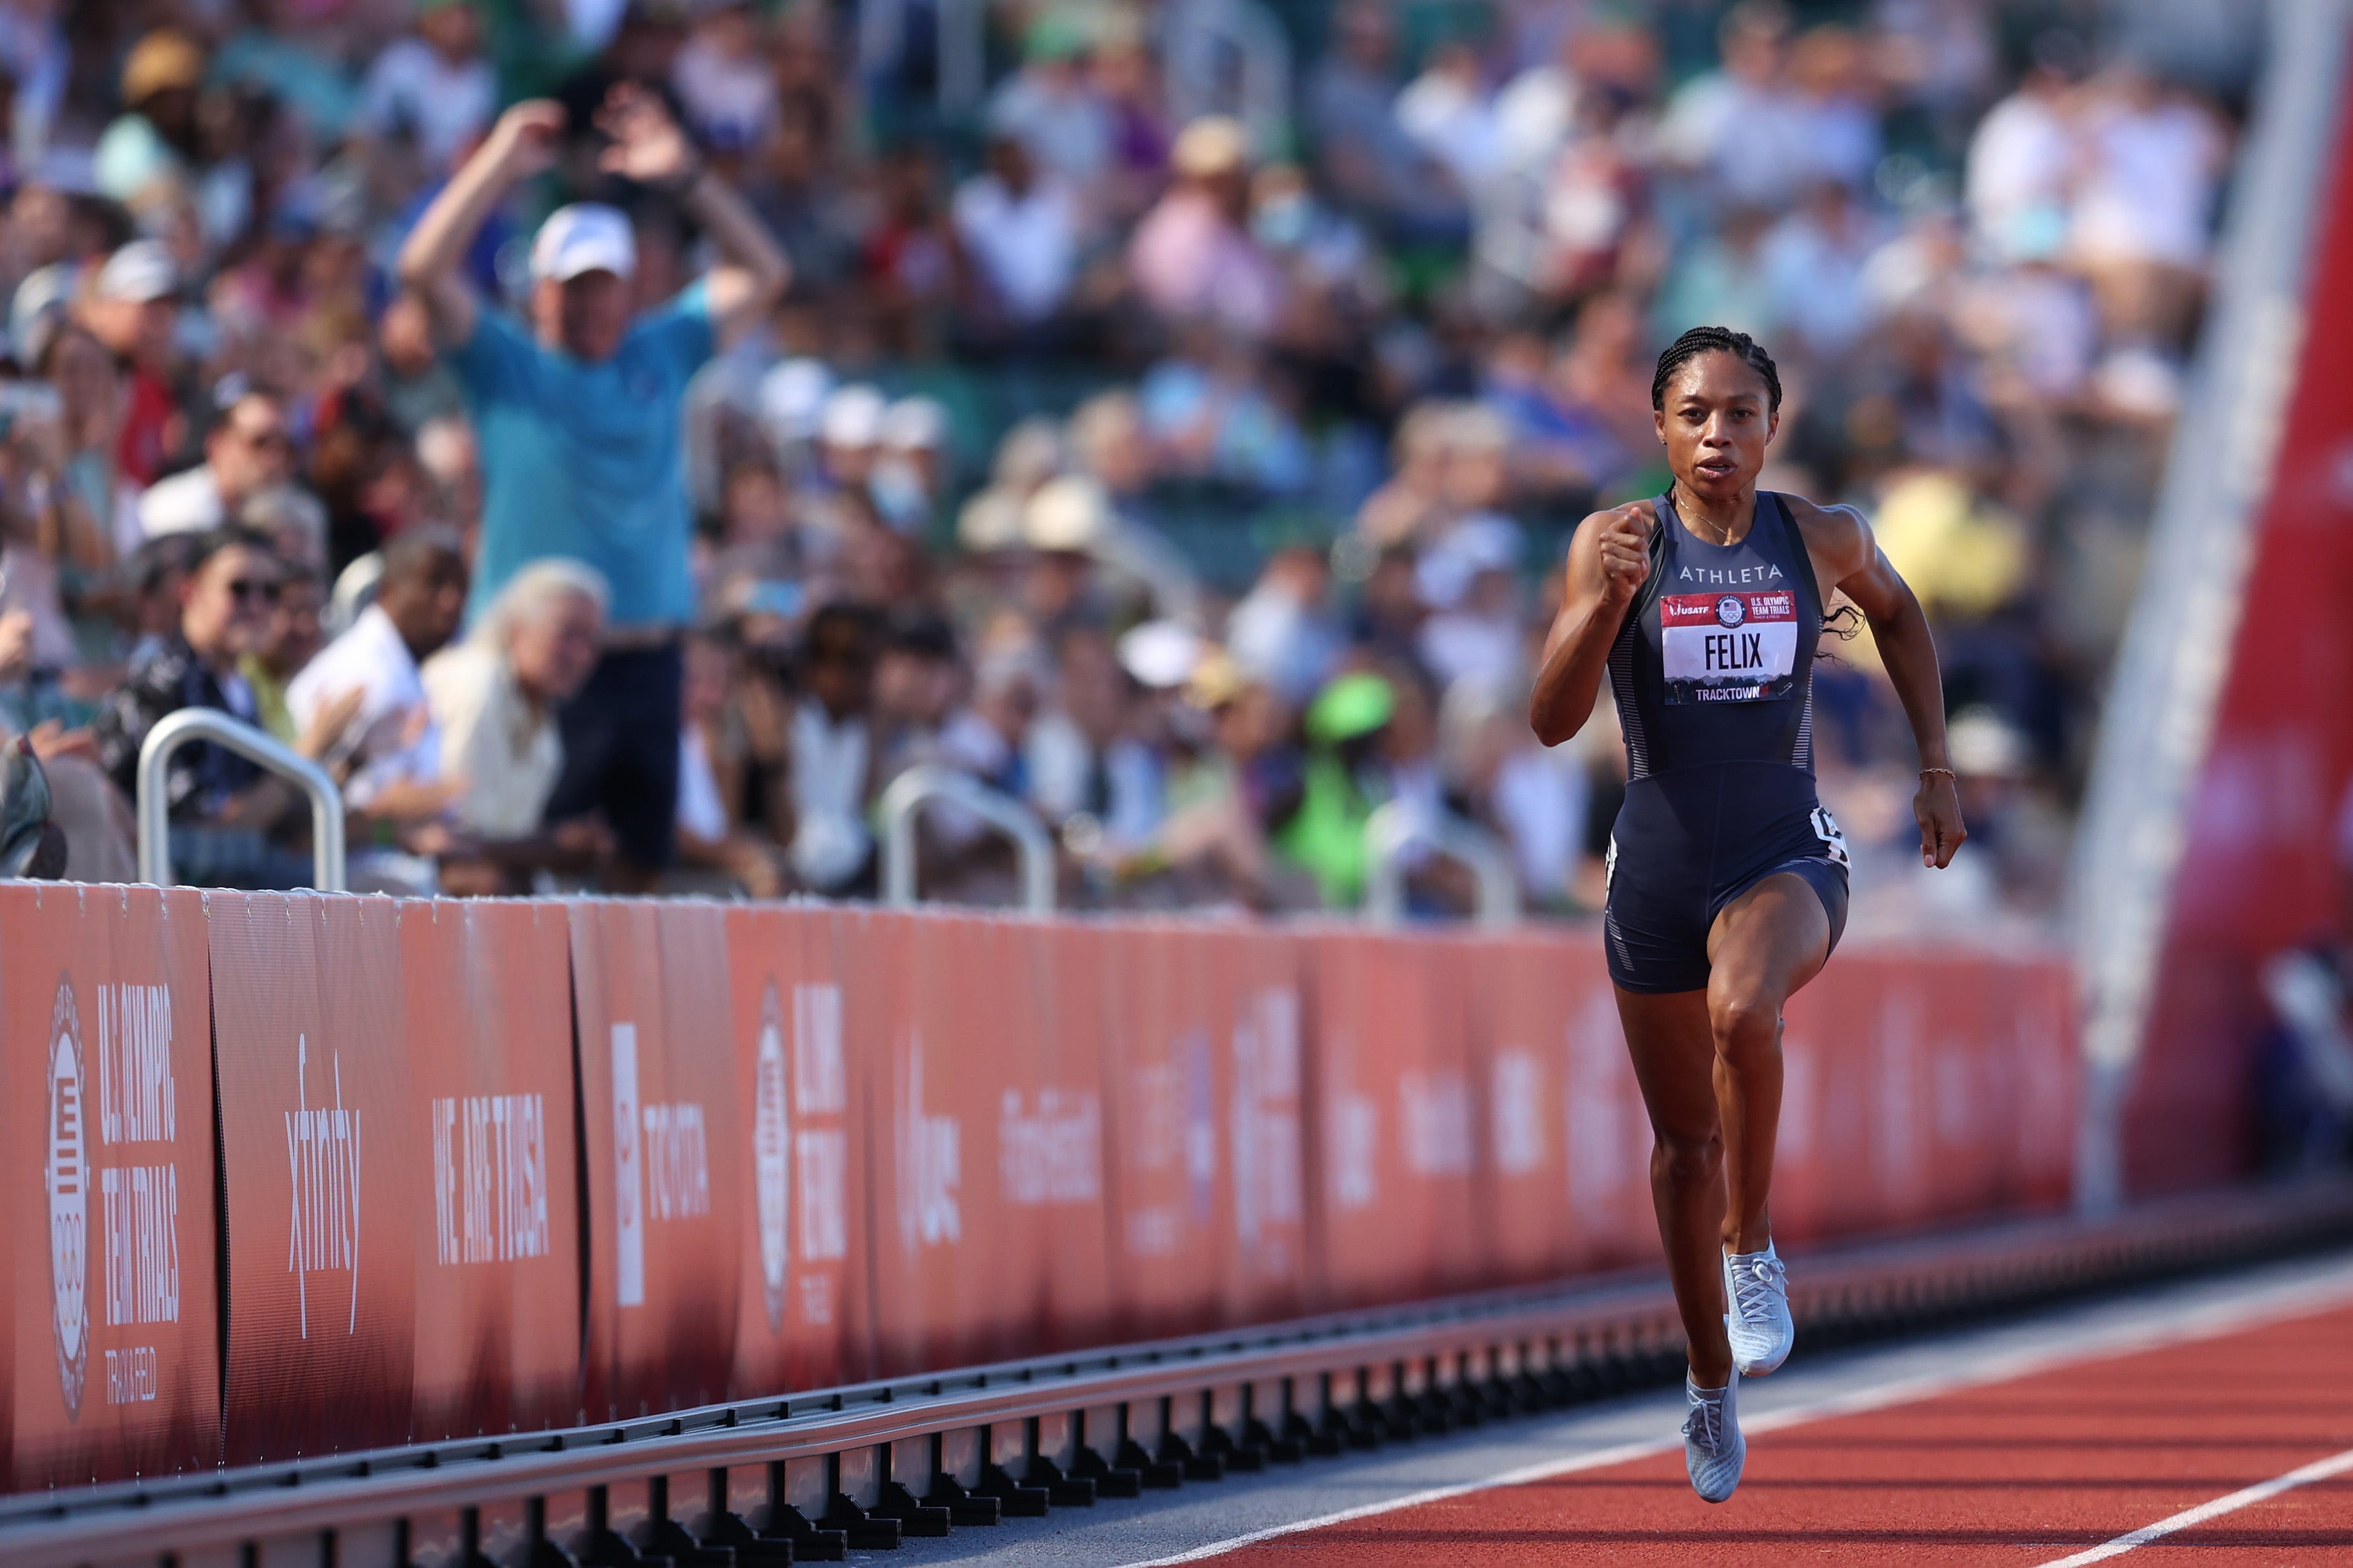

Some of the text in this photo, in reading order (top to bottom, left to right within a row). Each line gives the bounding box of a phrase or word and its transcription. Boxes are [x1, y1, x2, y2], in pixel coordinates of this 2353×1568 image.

[1679, 564, 1783, 584] ATHLETA
[1681, 606, 1709, 615] USATF
[1750, 596, 1789, 606] U.S. OLYMPIC
[1752, 605, 1790, 615] TEAM TRIALS
[1705, 633, 1763, 671] FELIX
[1695, 685, 1760, 701] TRACKTOWN
[121, 981, 175, 1143] OLYMPIC
[284, 1033, 361, 1339] xfinity
[432, 1097, 459, 1265] WE
[462, 1097, 494, 1264] ARE
[133, 1162, 179, 1324] TRIALS
